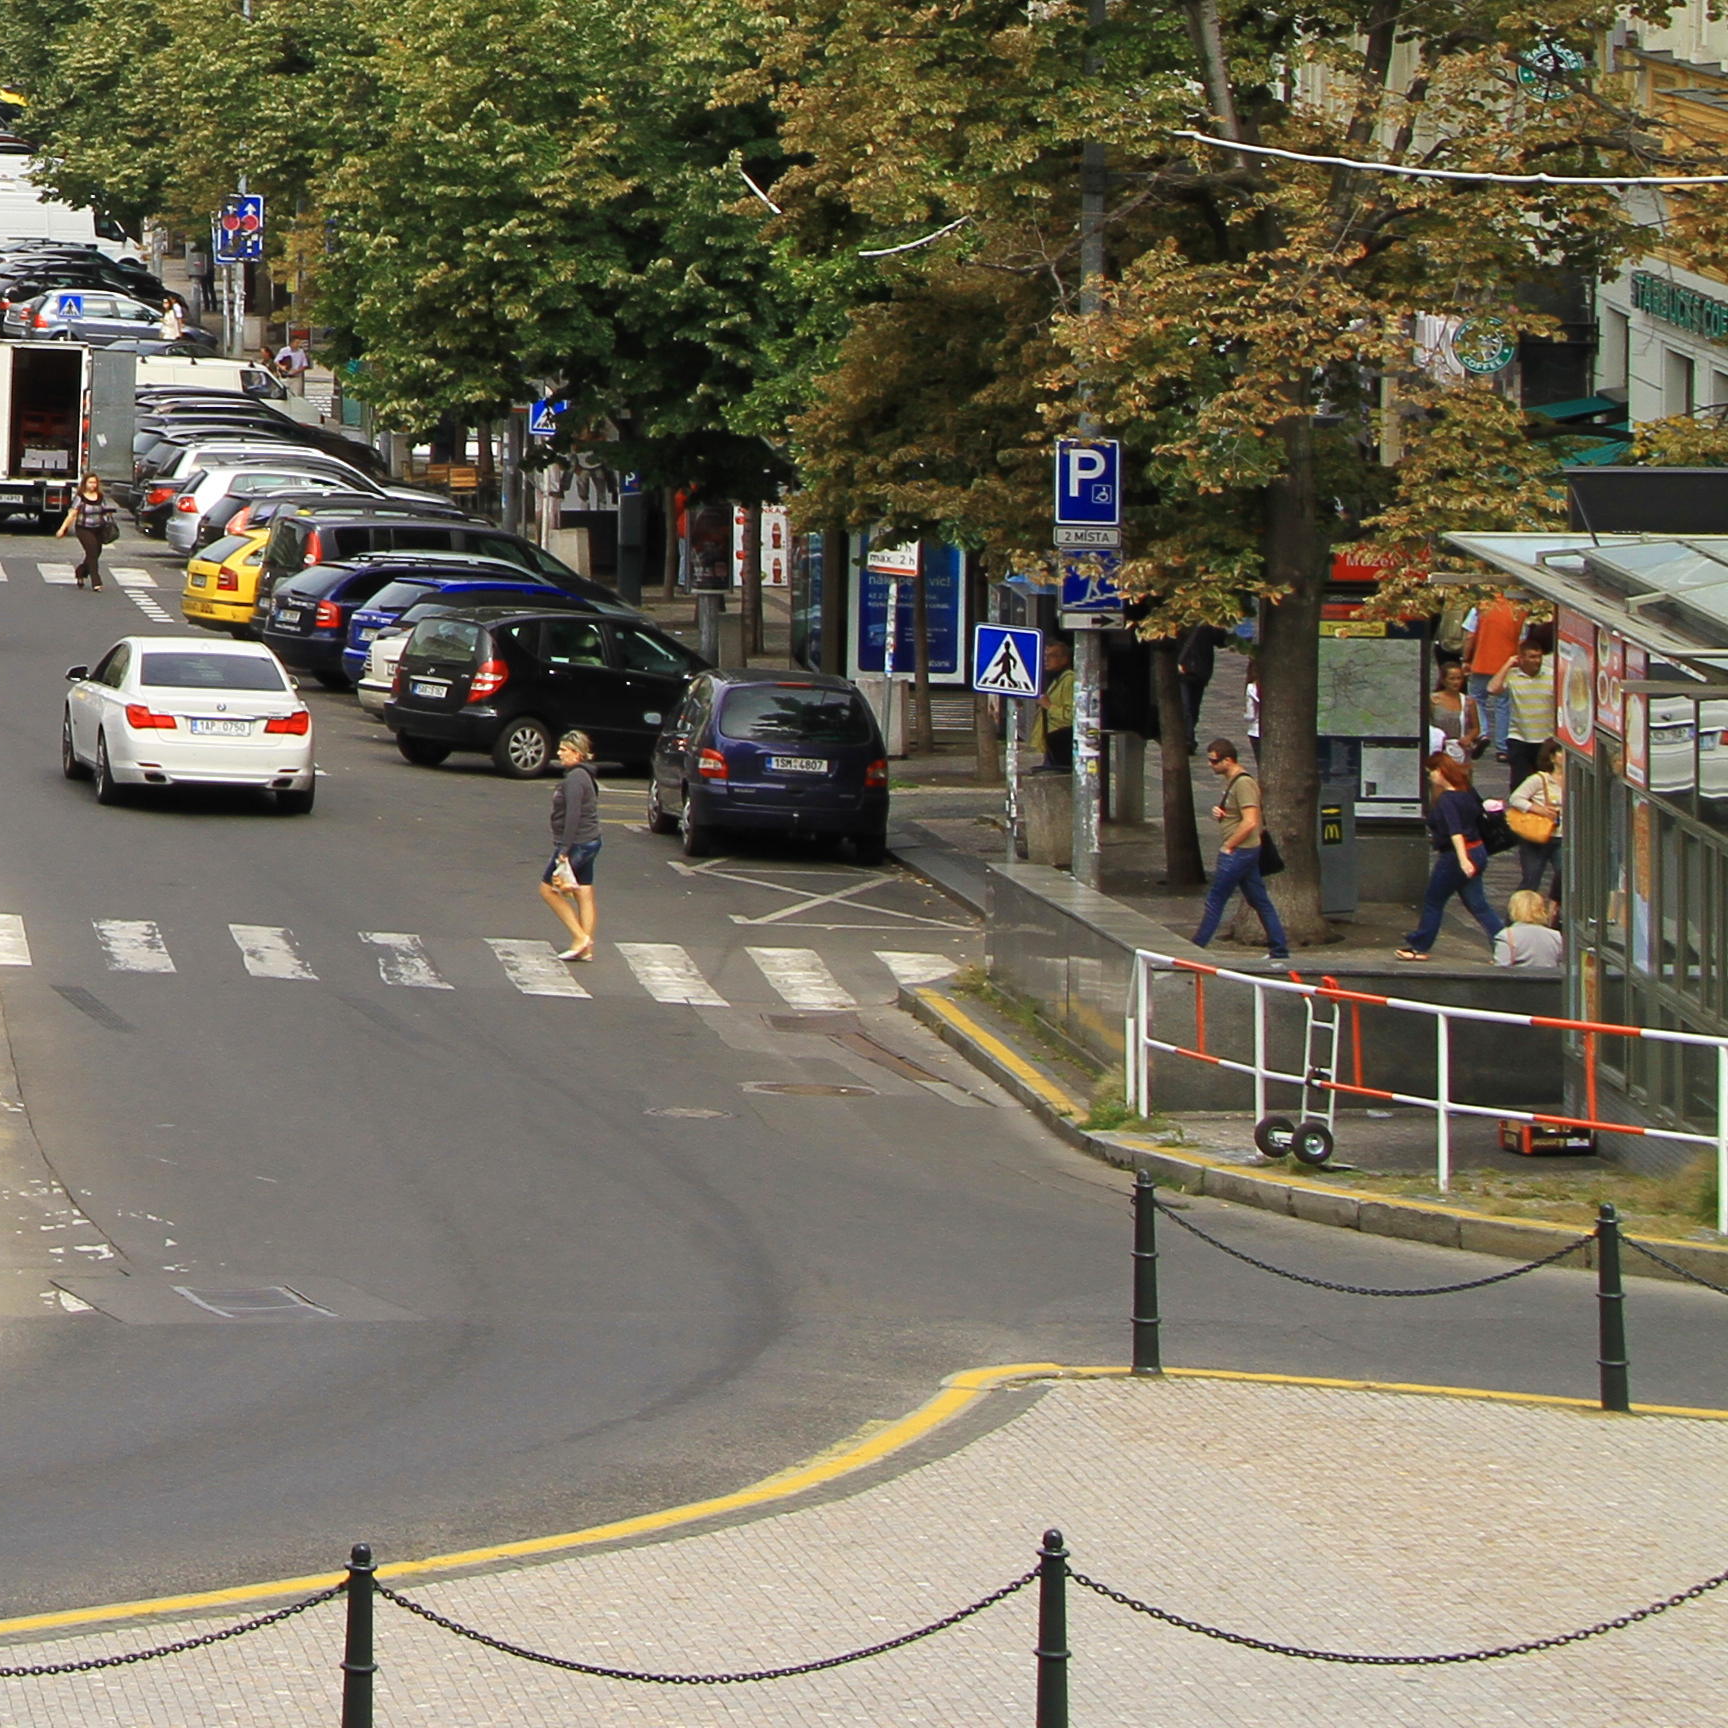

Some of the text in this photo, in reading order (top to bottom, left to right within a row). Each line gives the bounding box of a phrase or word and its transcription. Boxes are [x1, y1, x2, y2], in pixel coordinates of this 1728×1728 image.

[1462, 354, 1503, 371] COFFEE
[1068, 448, 1106, 498] P
[1064, 529, 1110, 543] 2 MÍSTA
[869, 554, 915, 565] max. 2 h
[775, 758, 824, 771] 1SM 4807
